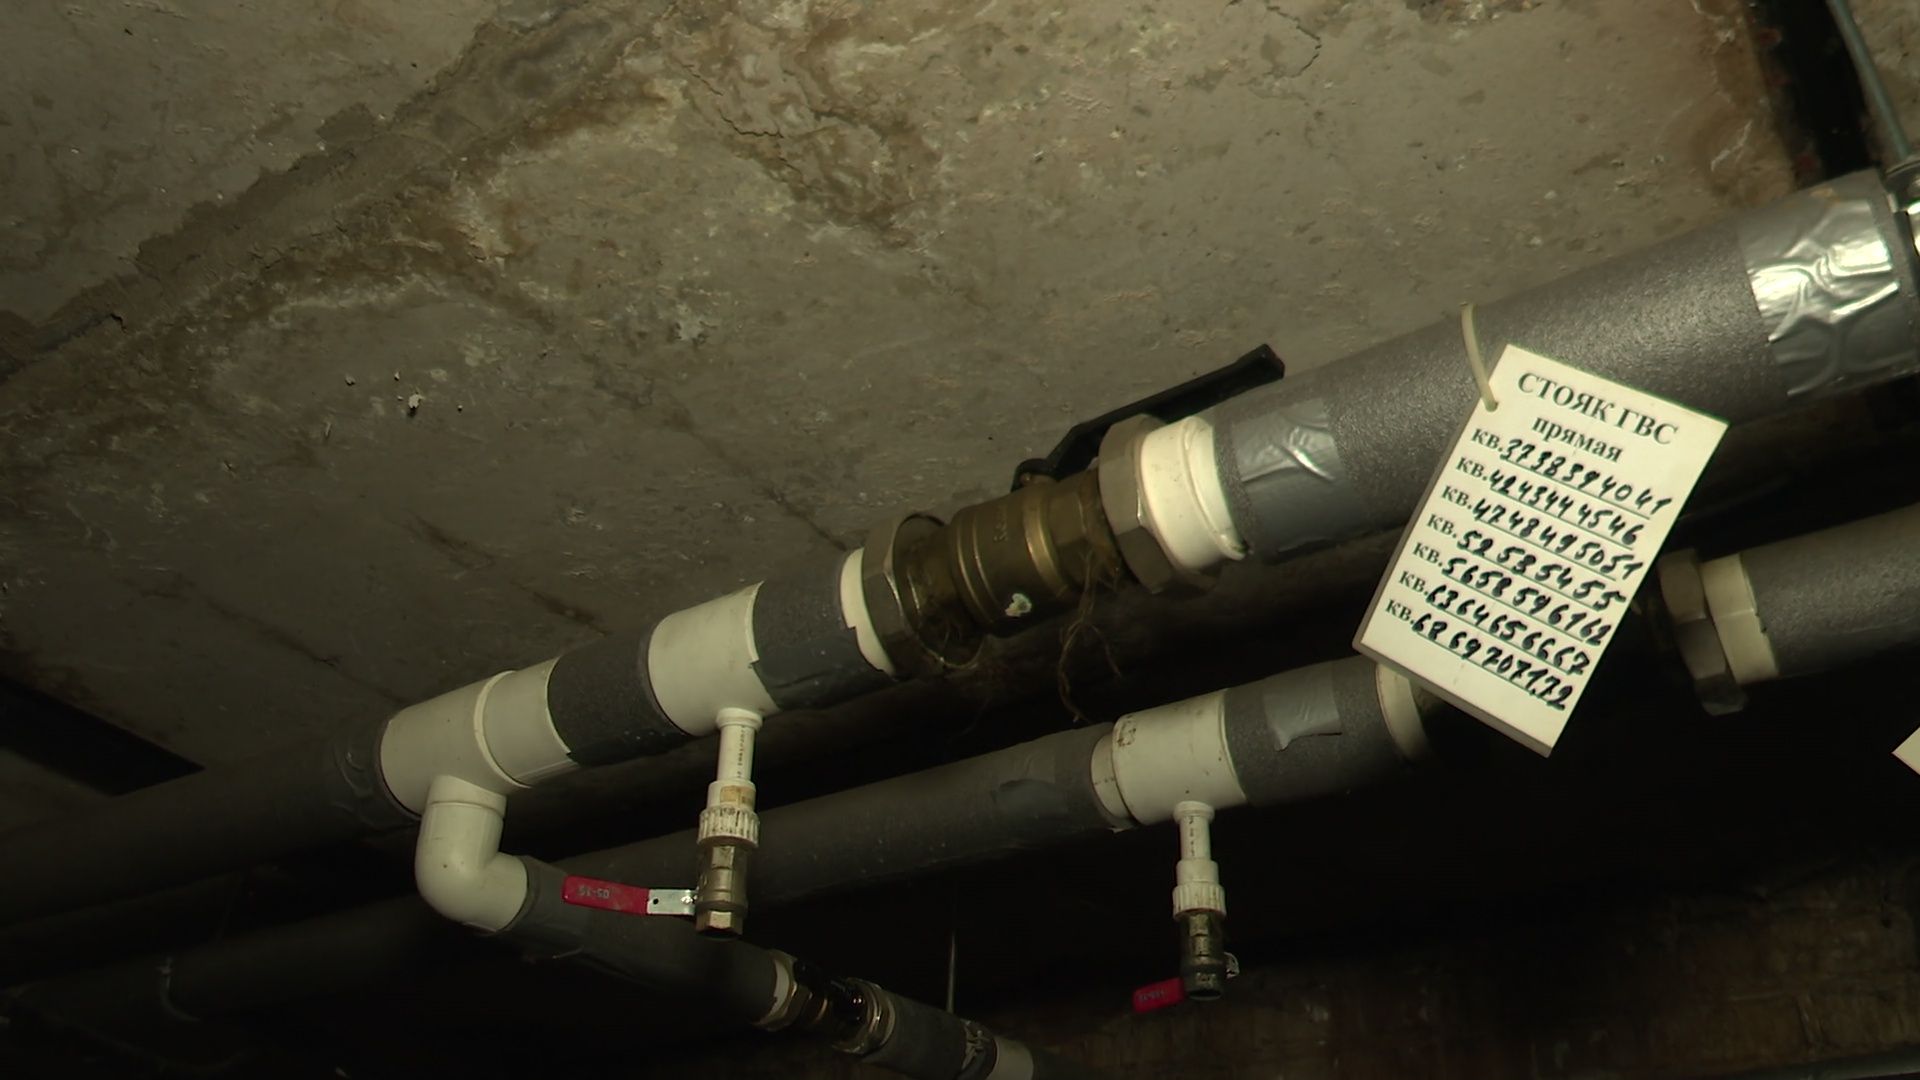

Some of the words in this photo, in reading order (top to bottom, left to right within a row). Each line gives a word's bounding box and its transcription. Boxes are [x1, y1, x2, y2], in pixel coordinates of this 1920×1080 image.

[1517, 372, 1616, 423] СТОЯК
[1615, 407, 1679, 444] ГВС
[1531, 416, 1624, 463] прямая
